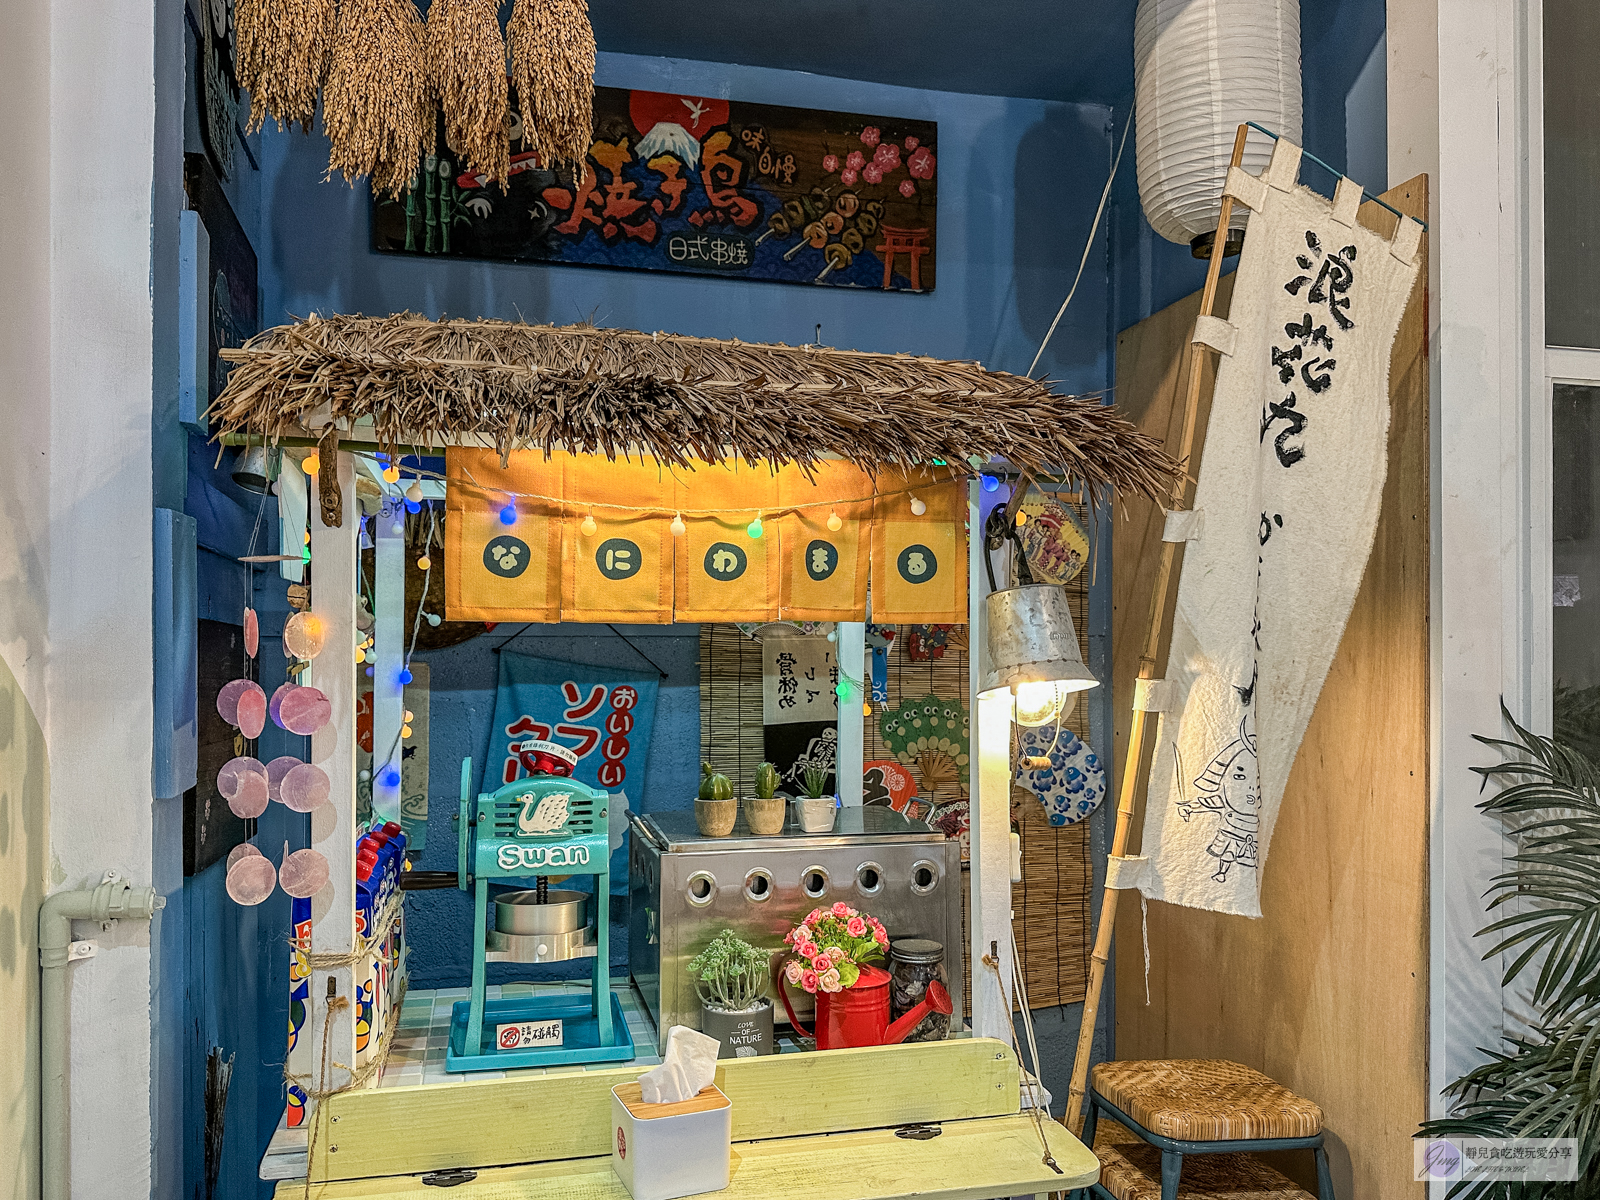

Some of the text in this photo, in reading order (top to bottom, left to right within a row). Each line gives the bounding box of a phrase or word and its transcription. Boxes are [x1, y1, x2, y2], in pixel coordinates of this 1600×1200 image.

[600, 686, 637, 786] おいしい
[498, 844, 589, 869] Swan
[729, 1033, 763, 1045] NATURE
[741, 1028, 751, 1036] OF
